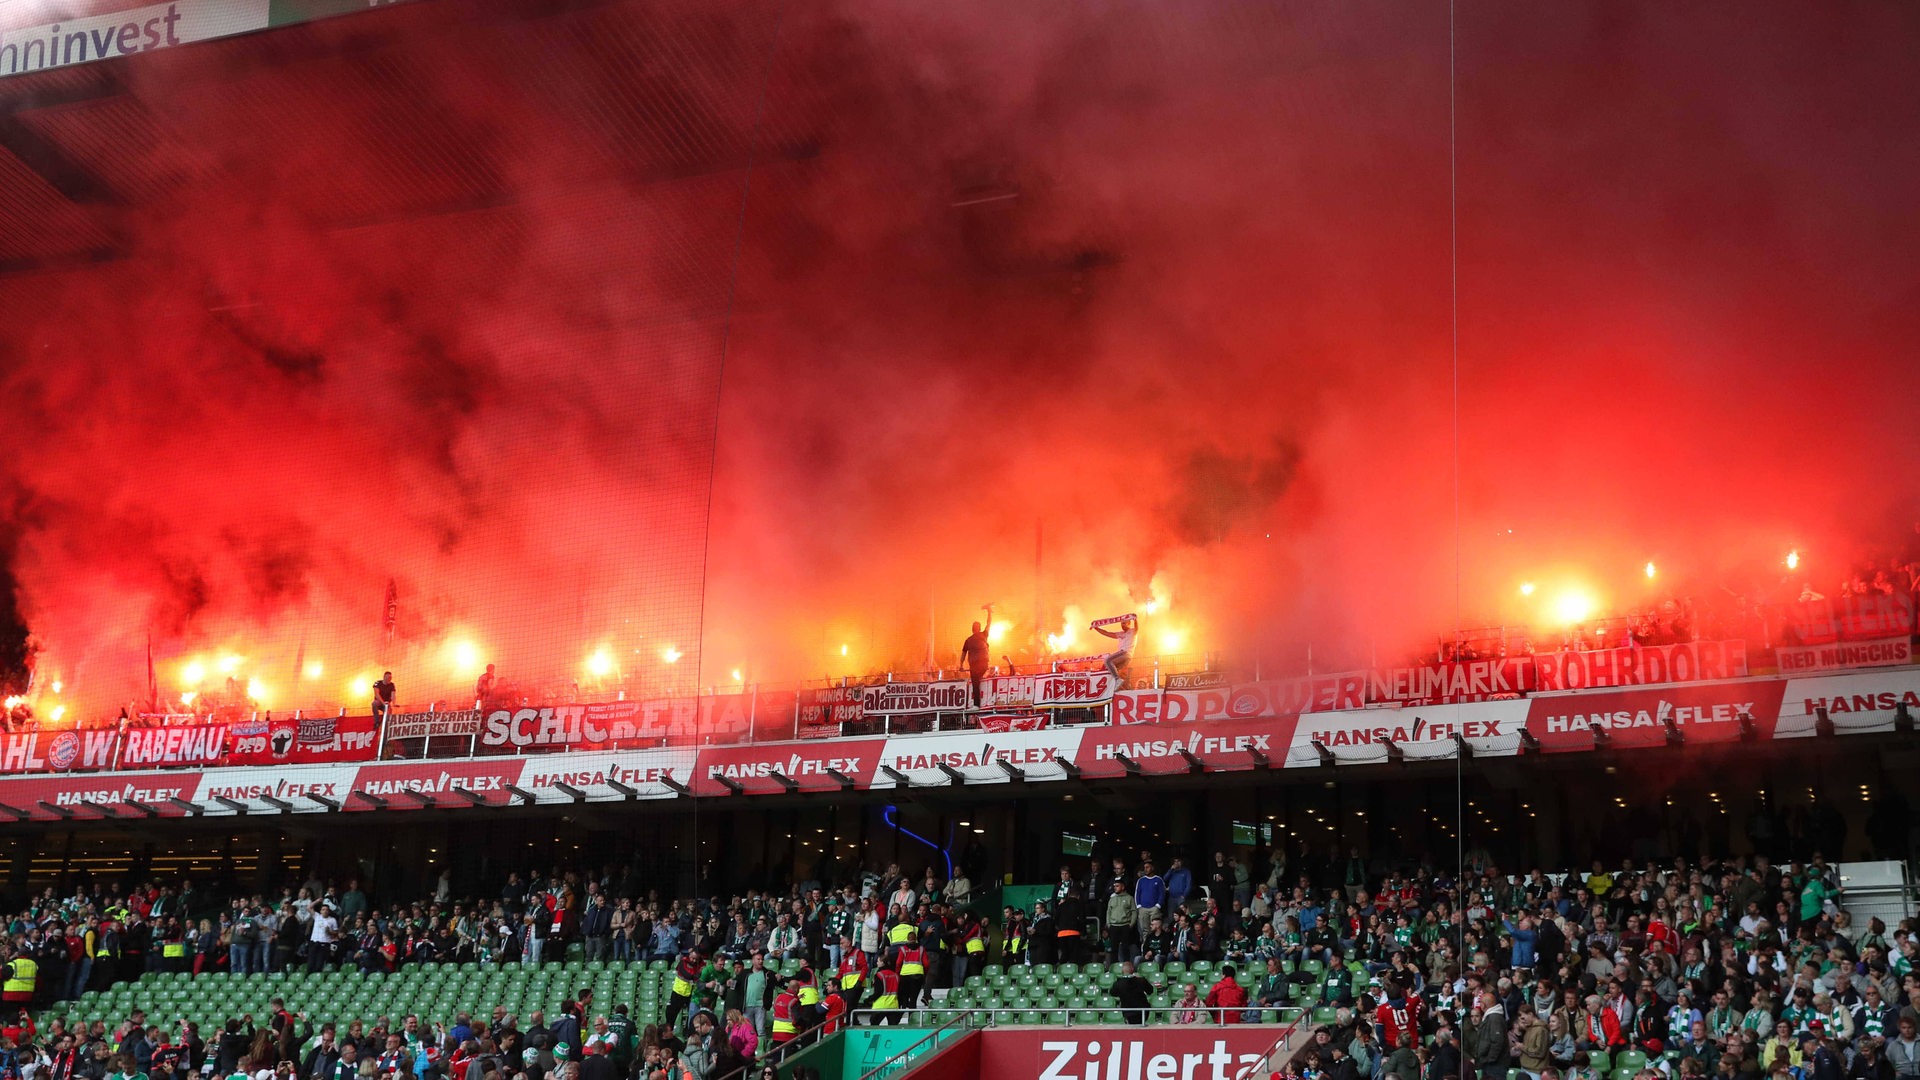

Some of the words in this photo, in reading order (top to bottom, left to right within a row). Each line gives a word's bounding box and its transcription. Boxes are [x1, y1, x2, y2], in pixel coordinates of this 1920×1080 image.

[1537, 641, 1744, 690] ROHRDORF
[1782, 651, 1815, 670] RED
[886, 684, 916, 694] Sektion
[1043, 677, 1107, 701] REBELS
[1370, 657, 1533, 700] NEUMARKT
[1112, 692, 1189, 726] RED
[1196, 675, 1364, 719] POWER
[389, 710, 481, 726] AUSGESPERRTE
[389, 724, 425, 738] IMMER
[429, 722, 448, 735] BEI
[452, 721, 478, 733] UNS
[0, 733, 44, 770] HL
[124, 726, 225, 763] RABENAU
[1392, 1008, 1409, 1026] 10
[1038, 1040, 1283, 1080] Zillerta
